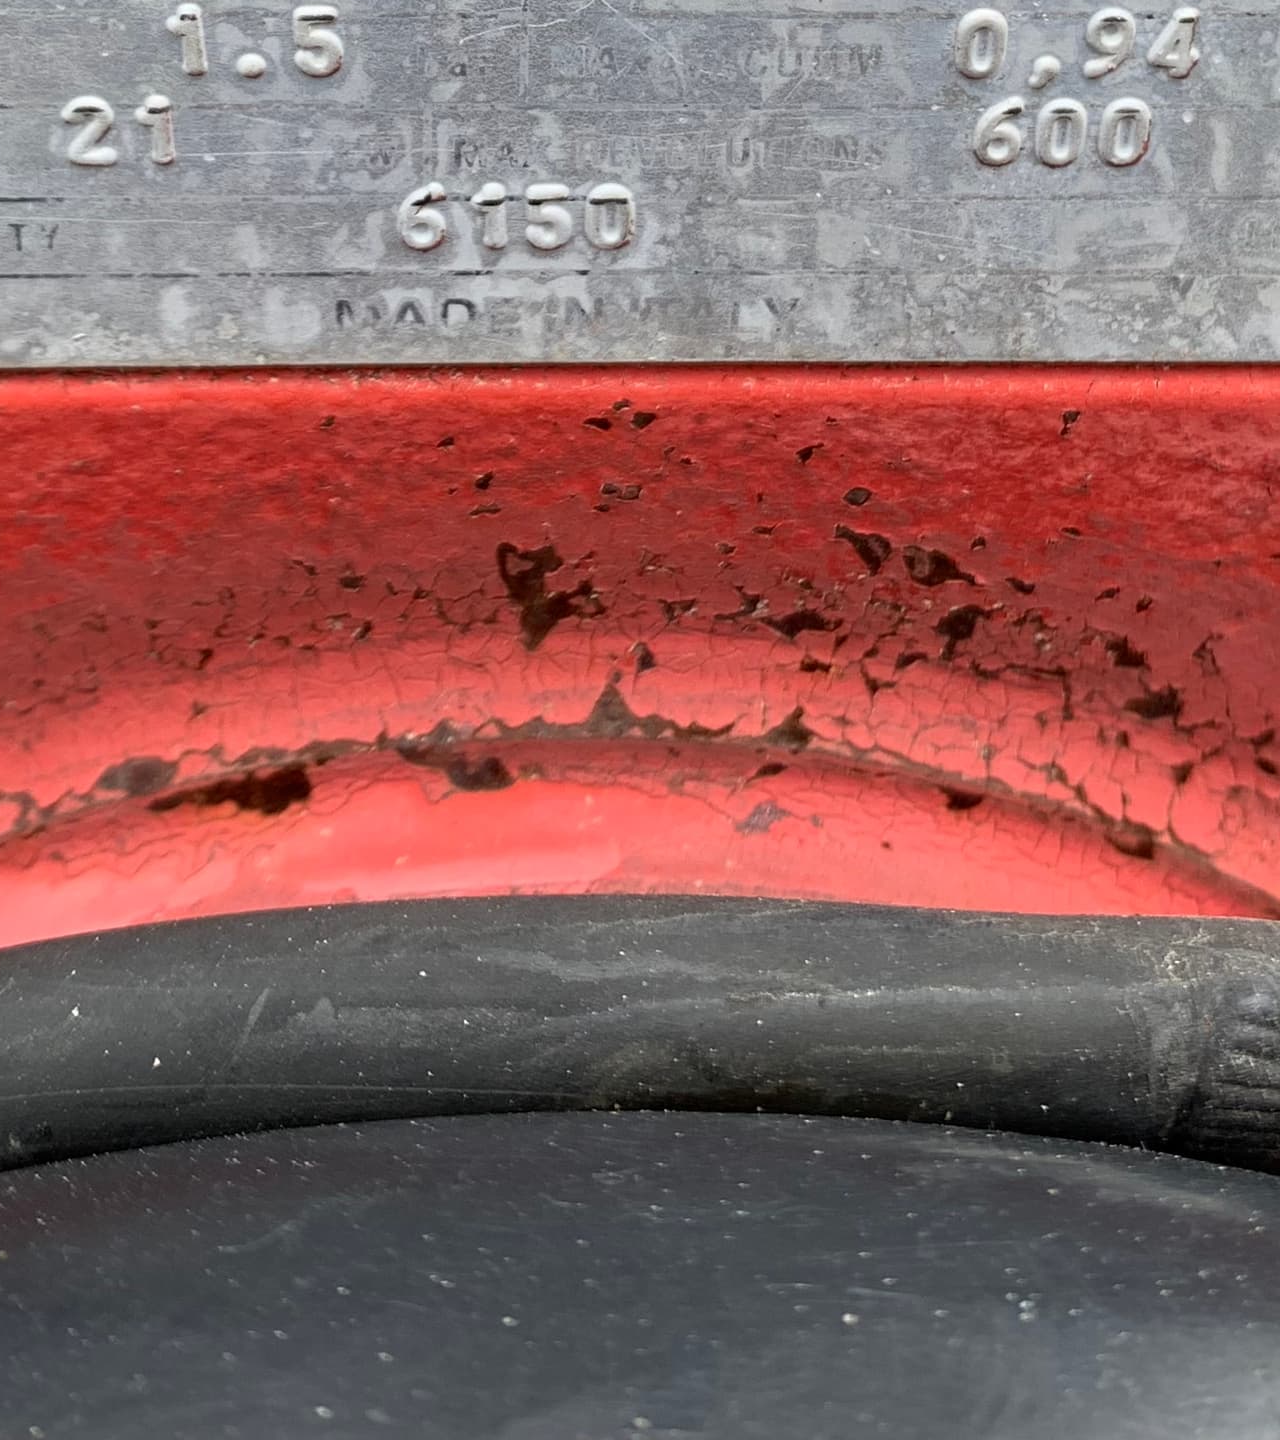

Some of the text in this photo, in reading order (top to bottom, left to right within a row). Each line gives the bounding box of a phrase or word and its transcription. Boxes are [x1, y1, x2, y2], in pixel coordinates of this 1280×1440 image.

[165, 3, 346, 77] 1.5
[60, 94, 177, 167] 21
[973, 95, 1152, 168] 600
[398, 181, 636, 250] 6150
